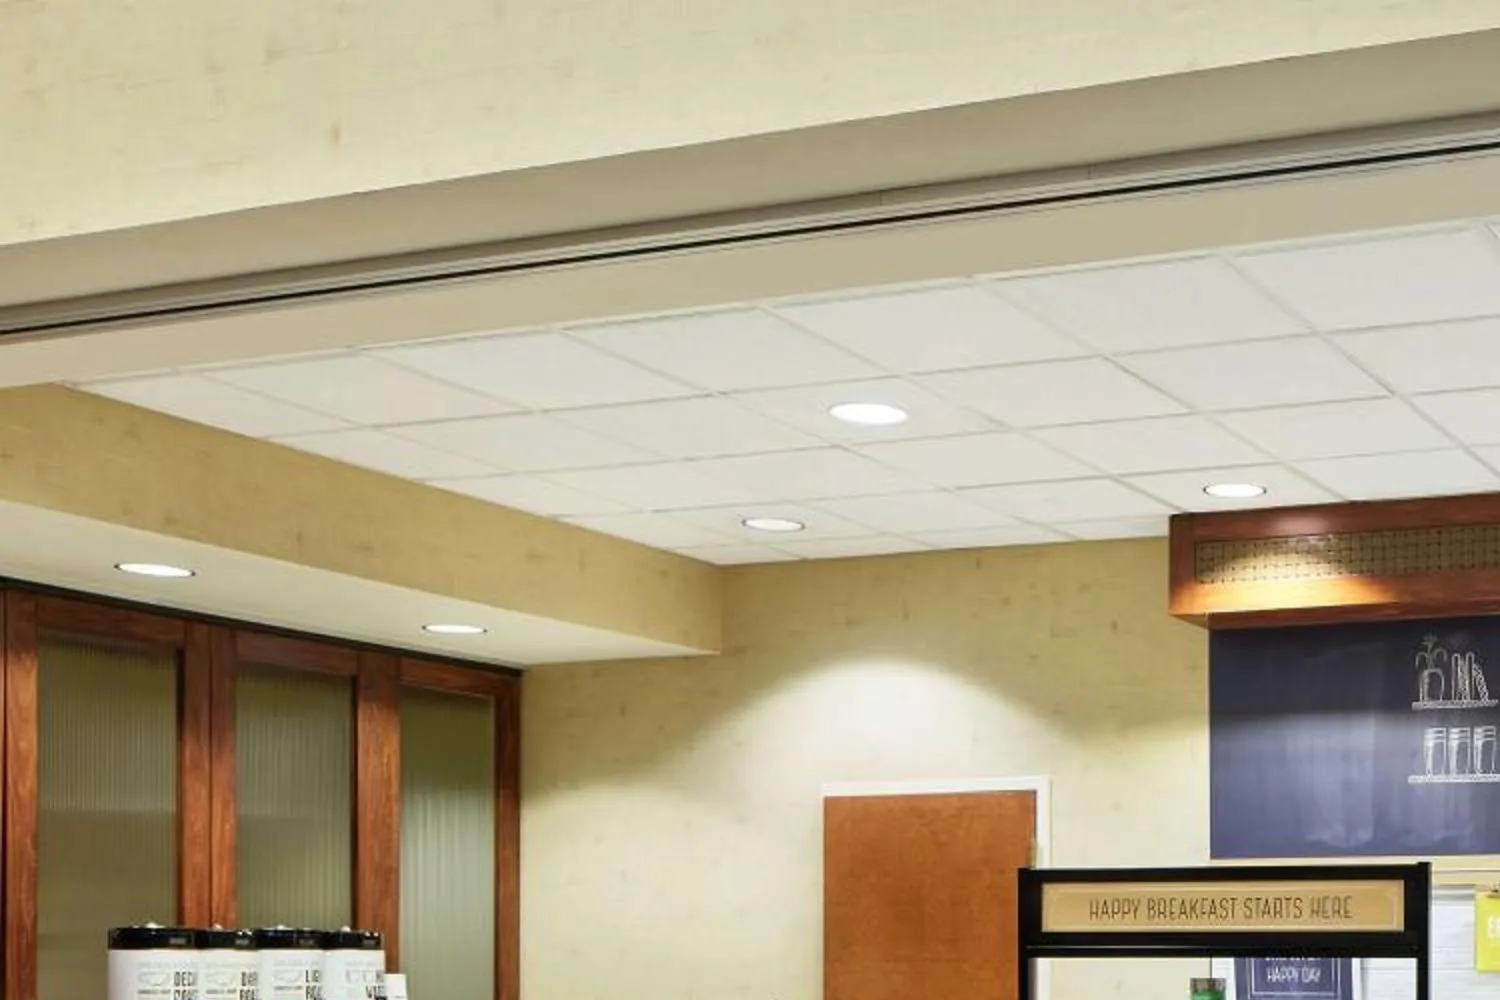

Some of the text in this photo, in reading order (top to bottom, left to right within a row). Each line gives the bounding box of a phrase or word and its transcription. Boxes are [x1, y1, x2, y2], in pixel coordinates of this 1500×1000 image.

[1088, 895, 1354, 921] HAPPY BREAKFAST STARTS HERE
